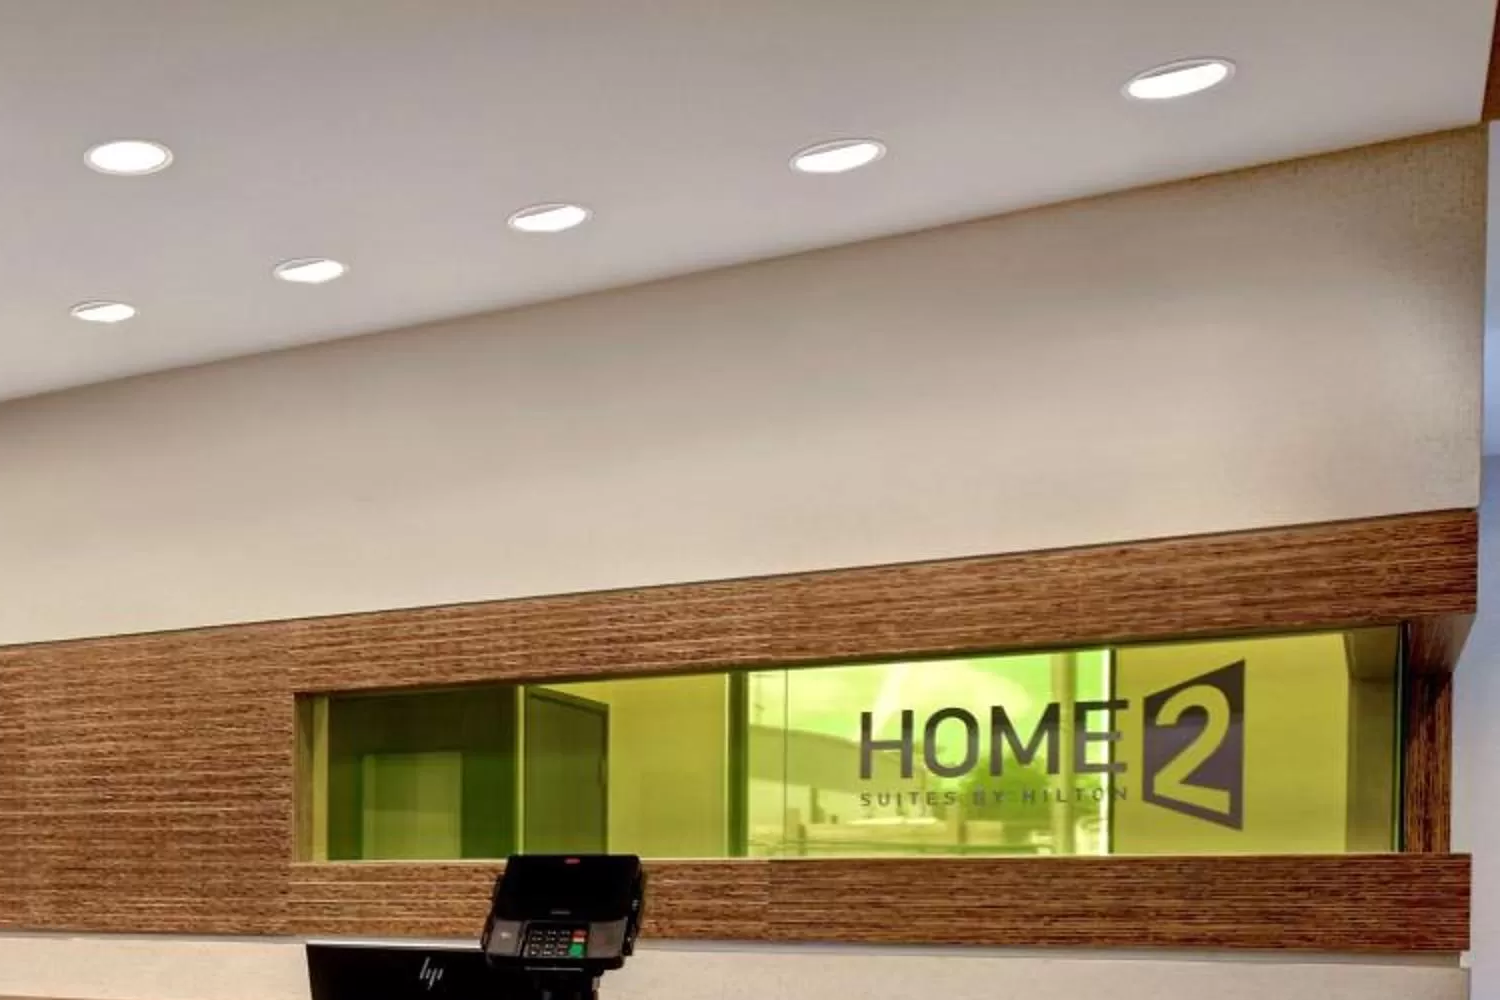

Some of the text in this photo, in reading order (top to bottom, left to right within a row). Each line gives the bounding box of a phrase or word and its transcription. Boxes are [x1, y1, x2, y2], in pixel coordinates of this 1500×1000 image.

[860, 786, 1128, 807] SUITES BY HILTON
[420, 957, 444, 990] hp
